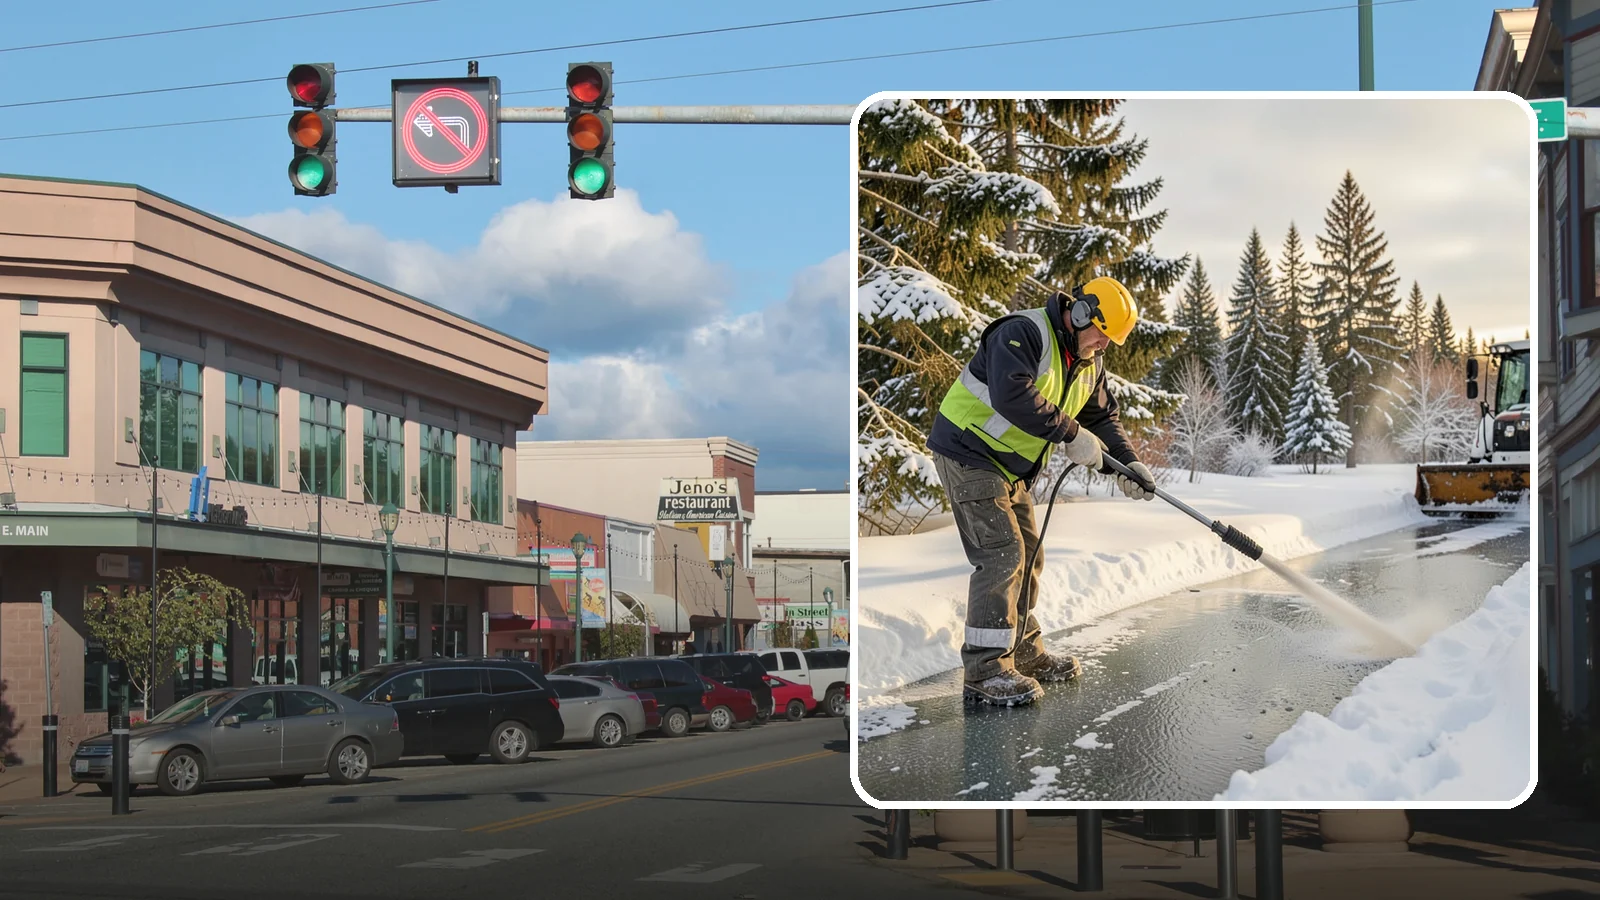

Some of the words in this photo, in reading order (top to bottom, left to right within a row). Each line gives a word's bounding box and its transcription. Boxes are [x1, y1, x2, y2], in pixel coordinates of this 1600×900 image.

[669, 480, 728, 495] Jeno's
[665, 496, 731, 509] restaurant
[658, 509, 682, 520] Italian
[686, 509, 714, 520] American
[715, 509, 737, 520] Cuisine
[2, 525, 13, 536] E.
[15, 525, 49, 537] MAIN
[797, 607, 828, 617] Street
[791, 619, 824, 627] lass
